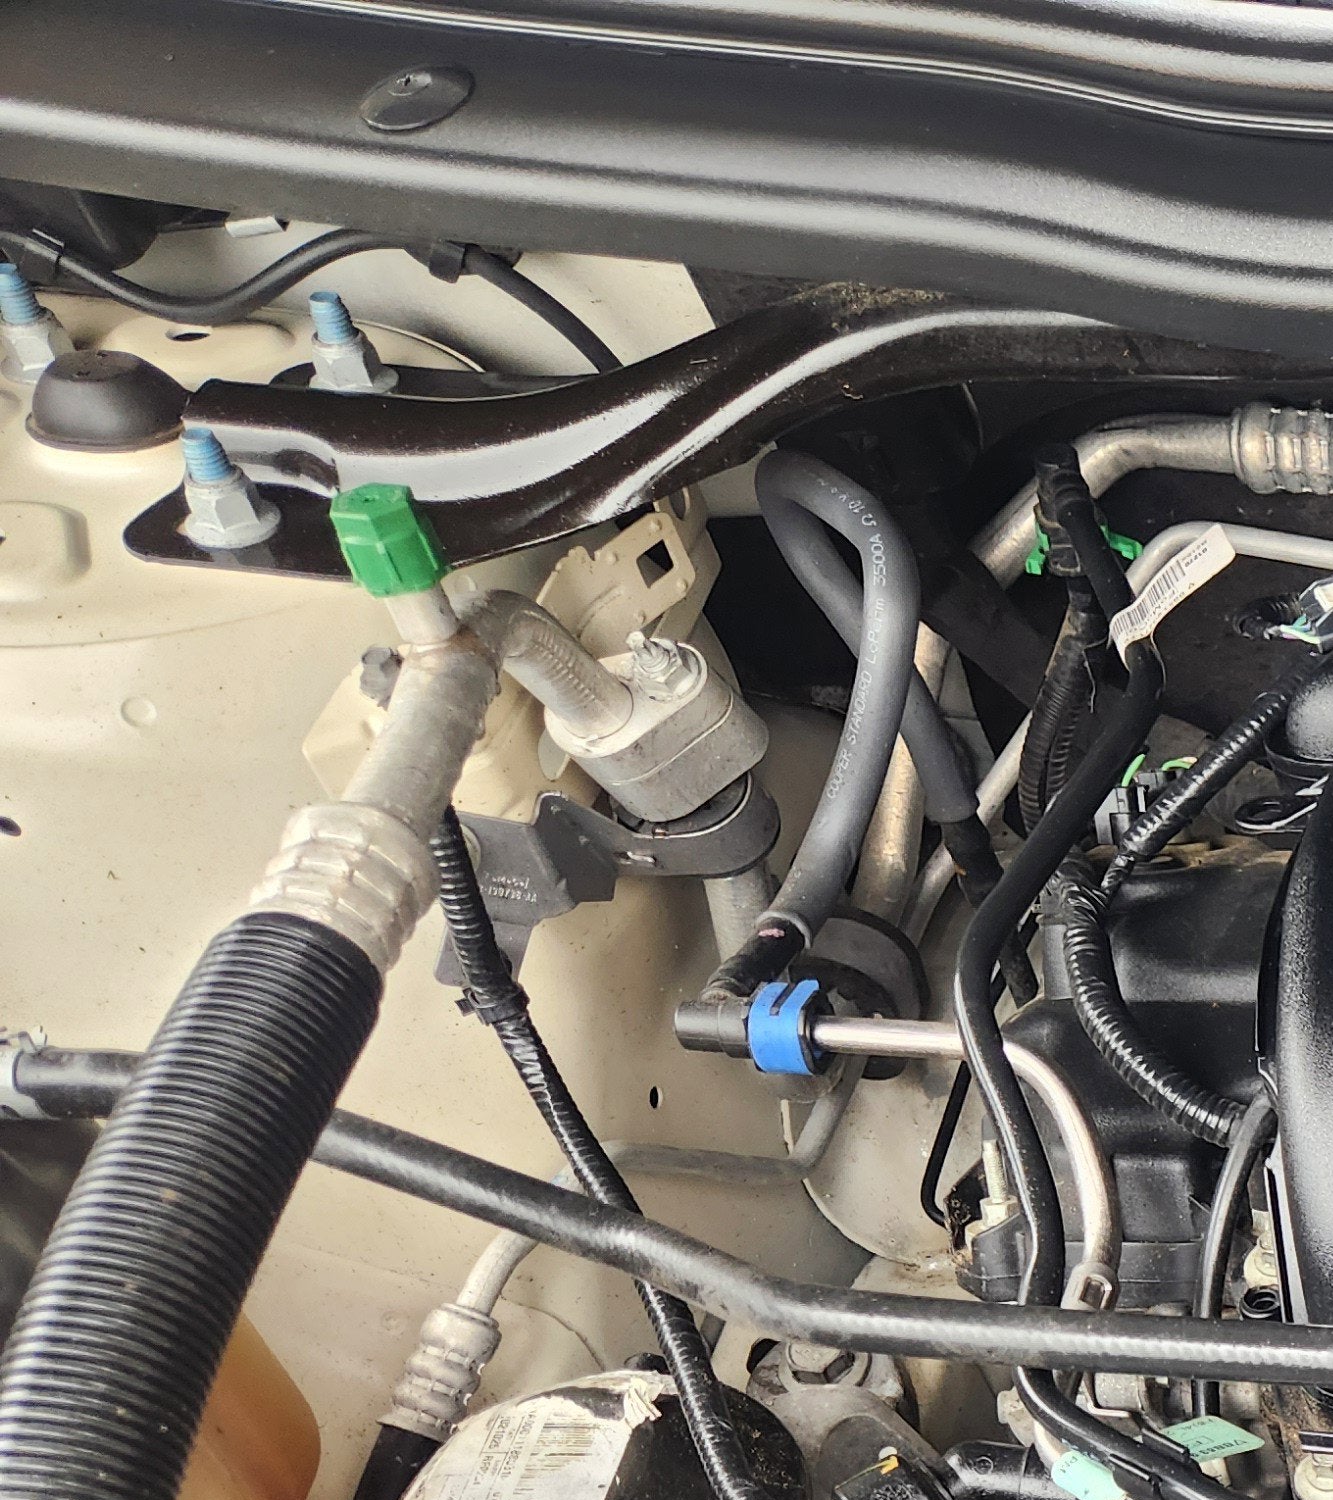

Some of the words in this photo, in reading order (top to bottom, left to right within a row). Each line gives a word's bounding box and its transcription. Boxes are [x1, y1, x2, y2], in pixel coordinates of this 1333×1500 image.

[869, 534, 886, 586] 3500A
[867, 598, 884, 665] LoPerm
[846, 670, 872, 745] STANDARD
